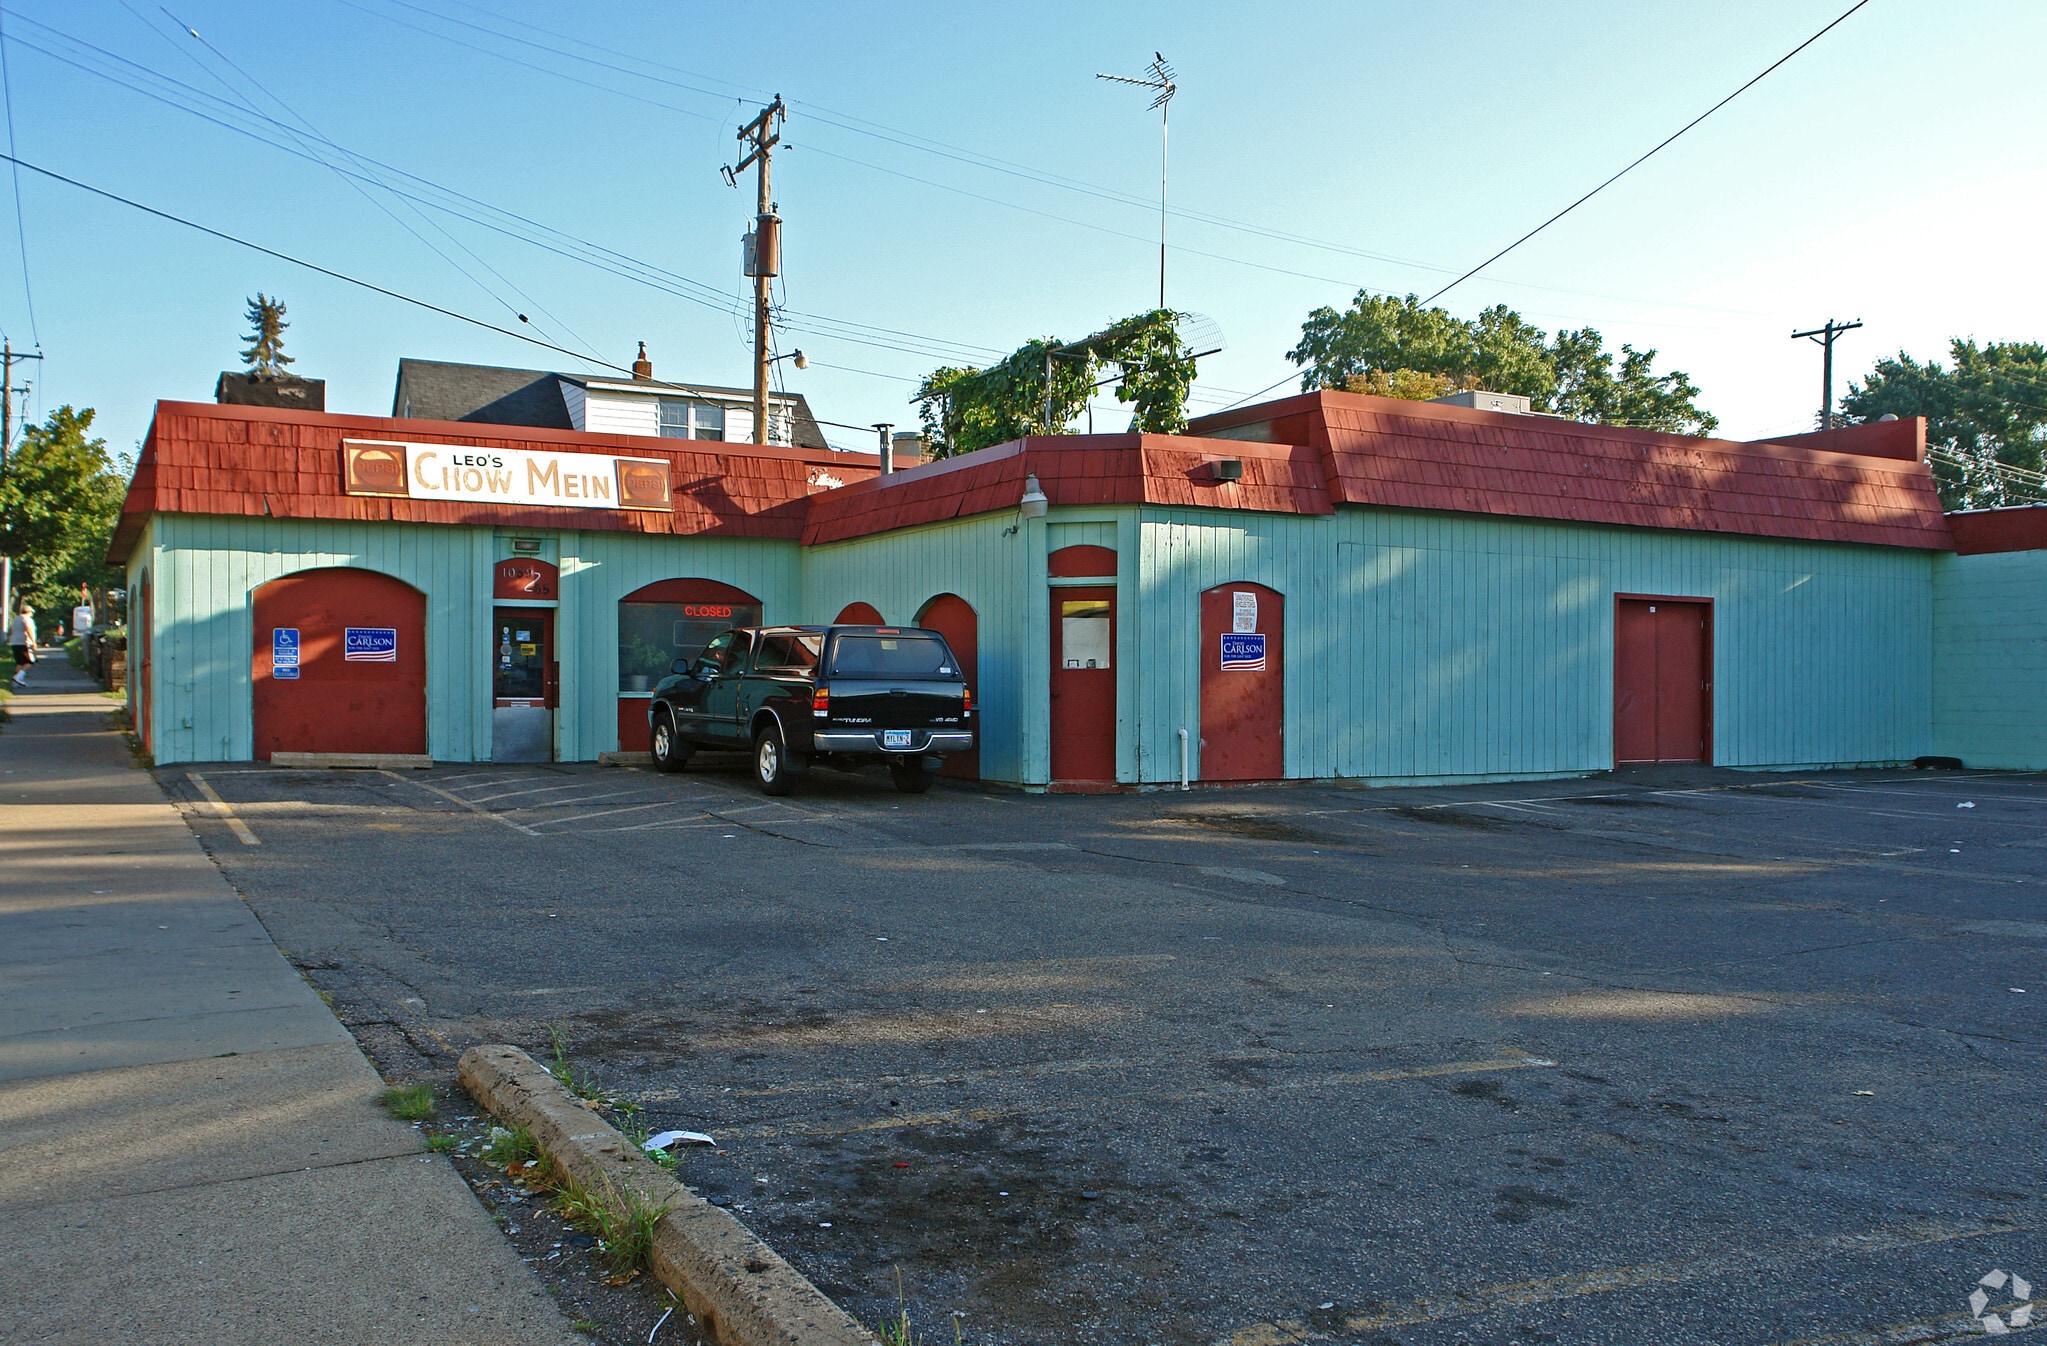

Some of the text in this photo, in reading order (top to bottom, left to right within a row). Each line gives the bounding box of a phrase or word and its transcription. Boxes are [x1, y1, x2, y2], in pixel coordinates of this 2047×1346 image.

[354, 460, 399, 475] PEPSI
[453, 454, 503, 468] LEO'S
[414, 451, 610, 500] CHOW MEIN
[626, 477, 664, 490] PEPSI
[684, 605, 732, 617] CLOSED
[348, 636, 392, 647] CARLSON
[1224, 642, 1262, 654] CARLSON
